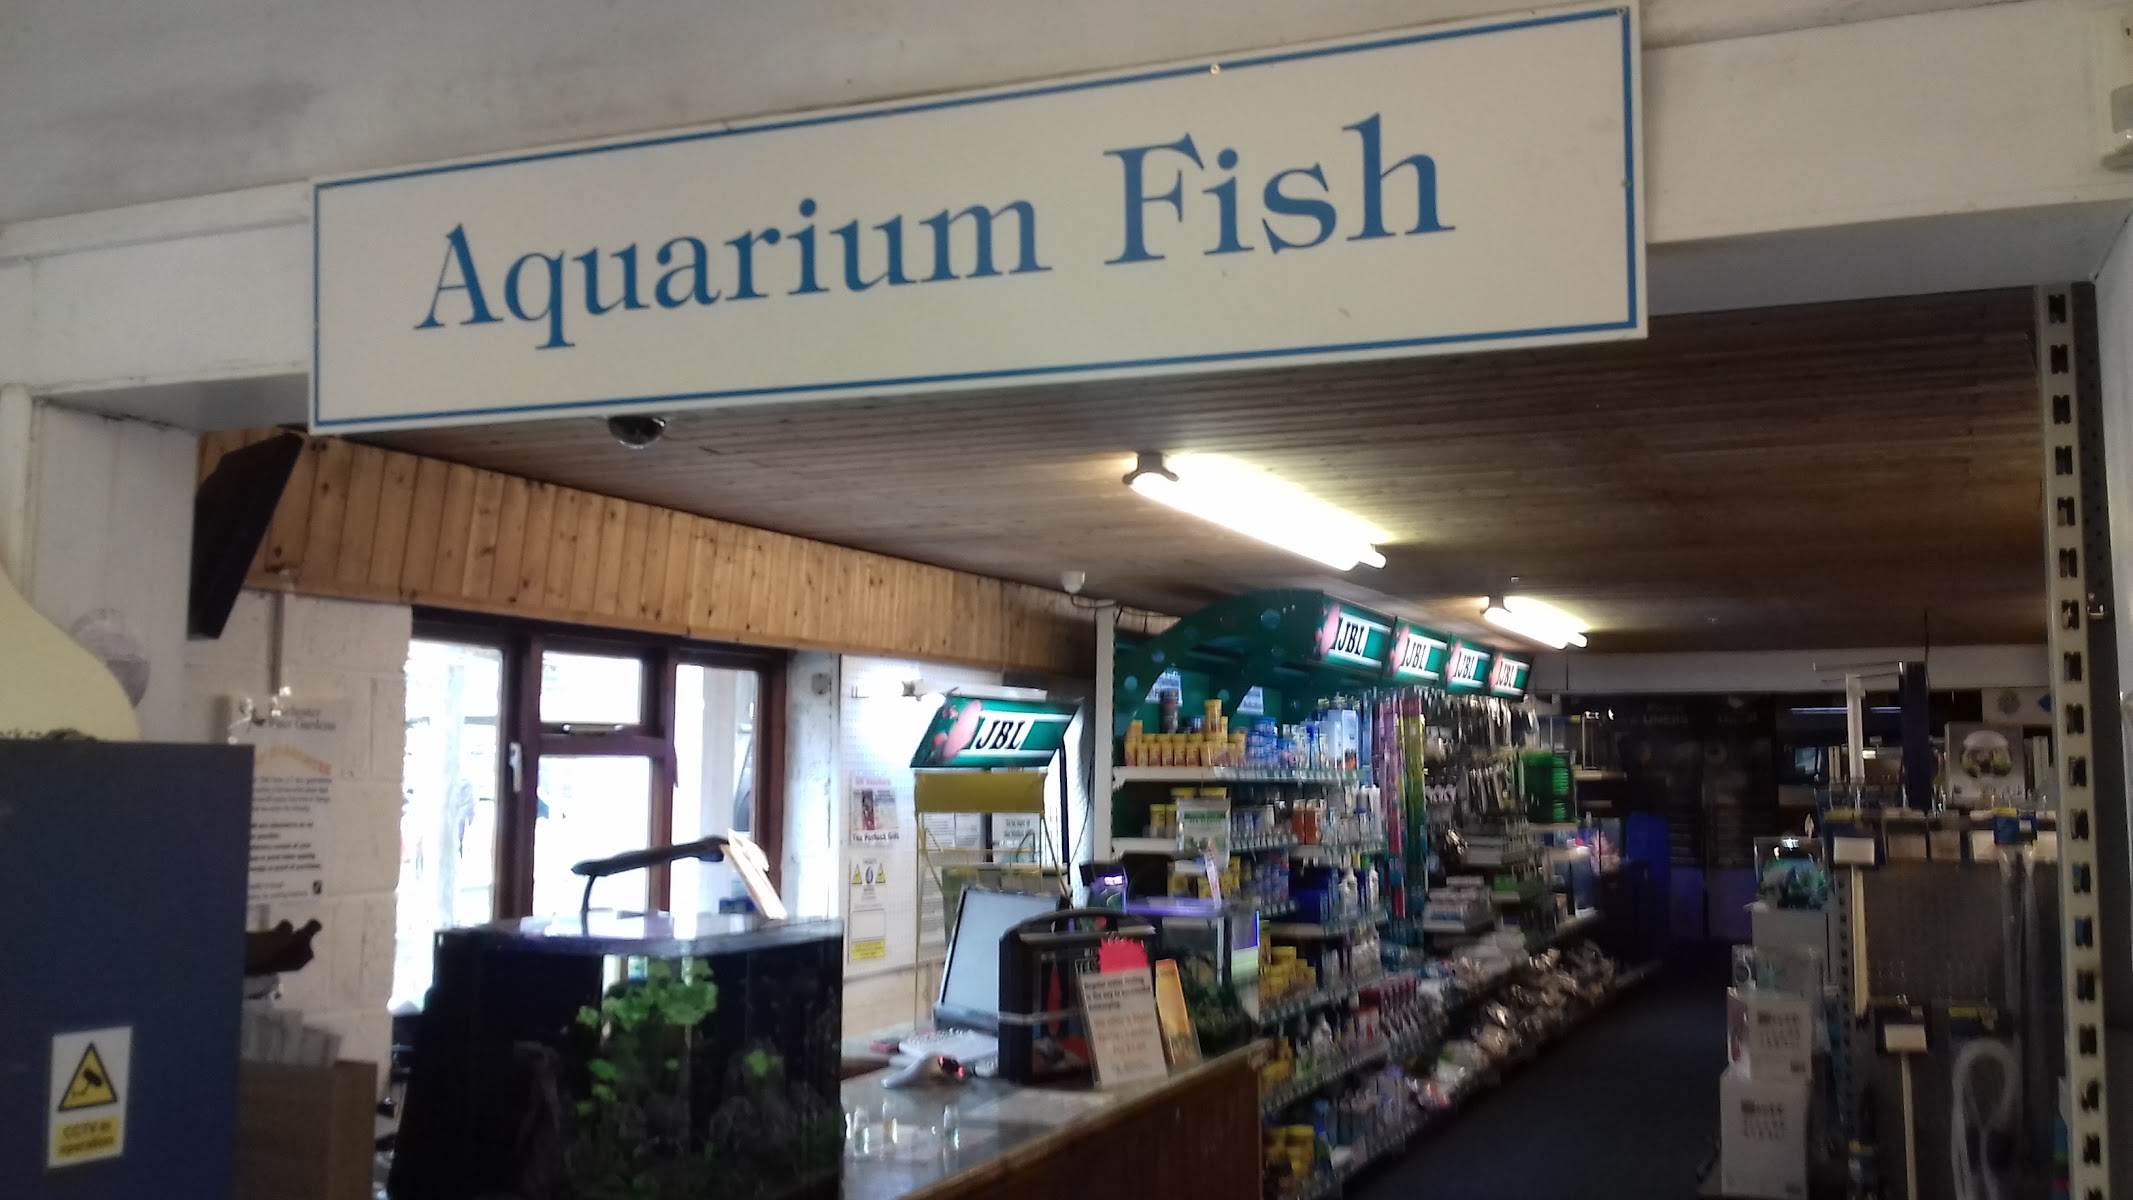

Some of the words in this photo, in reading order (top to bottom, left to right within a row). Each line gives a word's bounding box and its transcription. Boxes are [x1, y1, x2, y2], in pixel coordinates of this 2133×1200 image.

[413, 198, 1053, 351] Aquarium
[1103, 113, 1455, 266] Fish
[1337, 621, 1365, 656] JBL
[1405, 639, 1427, 671] JBL
[1457, 650, 1475, 680] JBL
[1499, 662, 1515, 688] JBL
[975, 719, 1026, 750] JBL
[62, 1120, 98, 1138] CCTV
